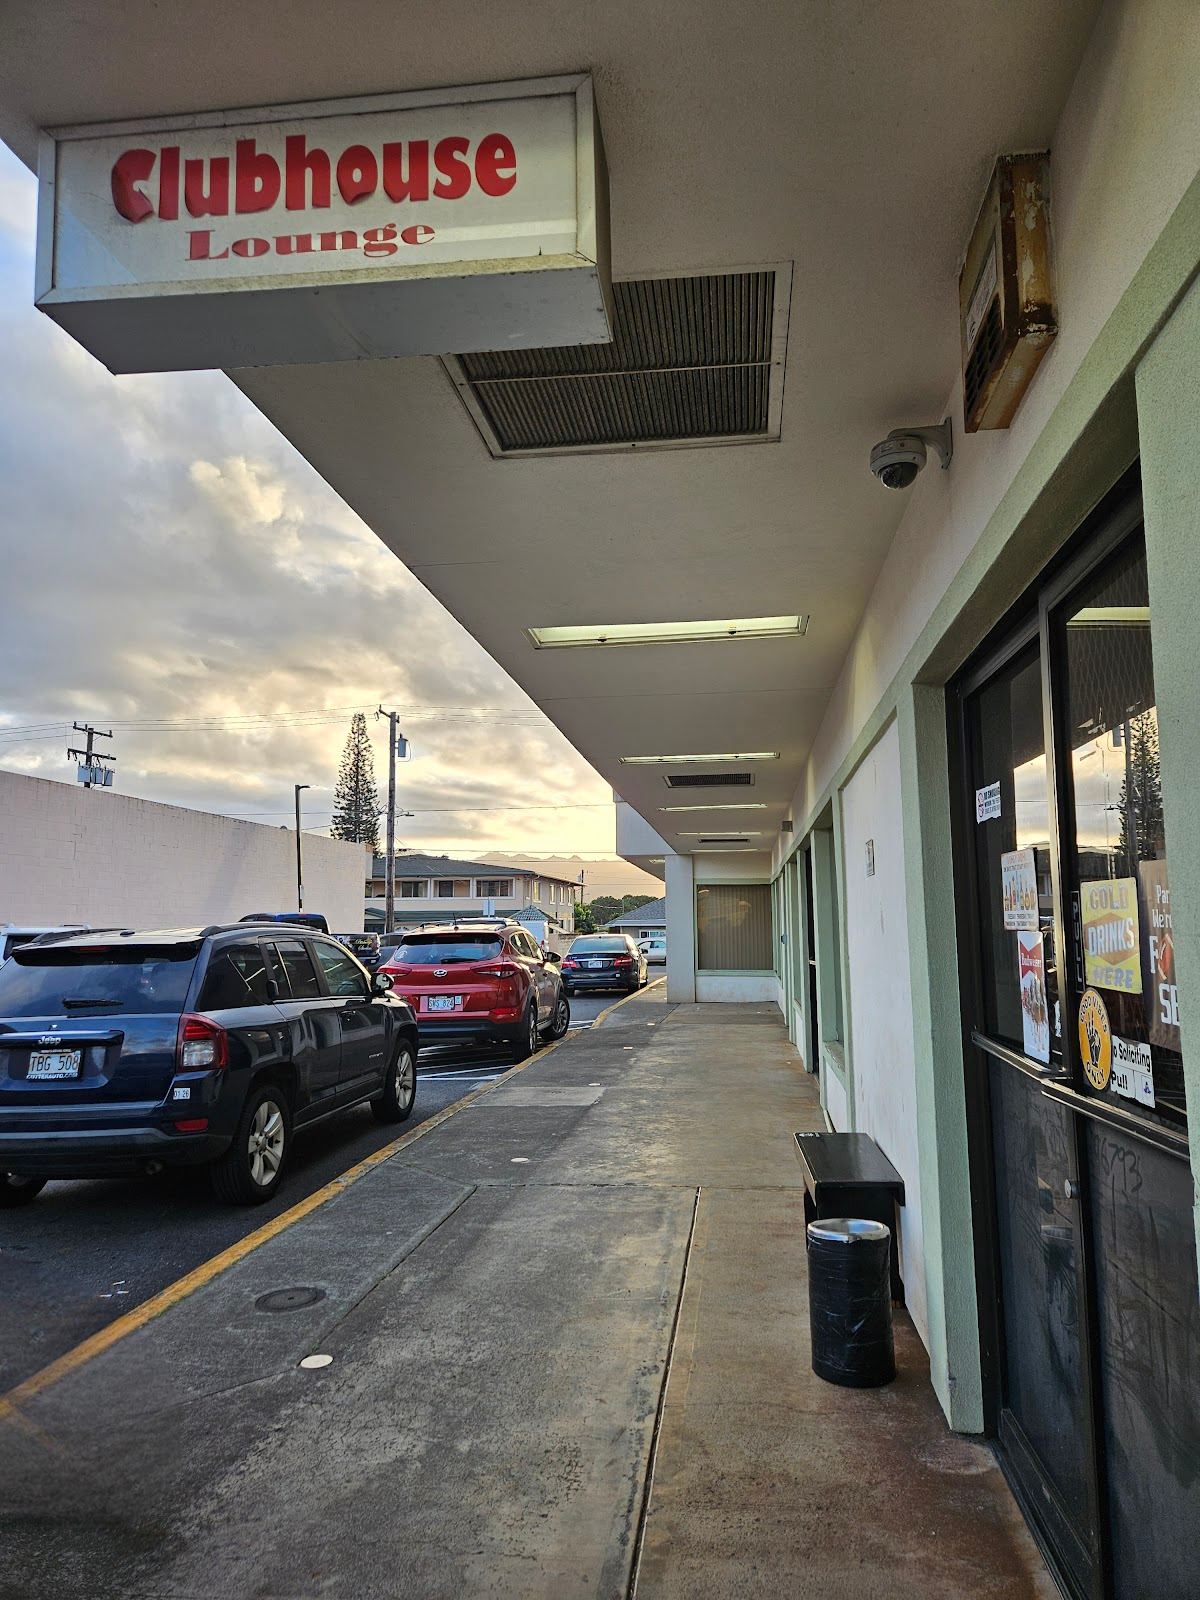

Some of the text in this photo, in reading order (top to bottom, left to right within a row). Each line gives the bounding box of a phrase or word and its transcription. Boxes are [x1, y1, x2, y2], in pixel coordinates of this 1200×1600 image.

[111, 132, 518, 224] Clubhouse
[184, 222, 436, 262] Lounge
[1088, 883, 1129, 911] COLD
[1151, 908, 1172, 929] We'r
[1072, 901, 1083, 983] PULL
[1088, 917, 1135, 957] DRINKS
[1092, 966, 1134, 989] HERE
[1080, 995, 1108, 1033] GOOD VIBES
[38, 1035, 62, 1045] Jeep
[31, 1055, 80, 1071] TBG 508
[1118, 1042, 1151, 1073] Soliciting
[1086, 1061, 1105, 1085] ONLY
[1111, 1070, 1128, 1091] Pull
